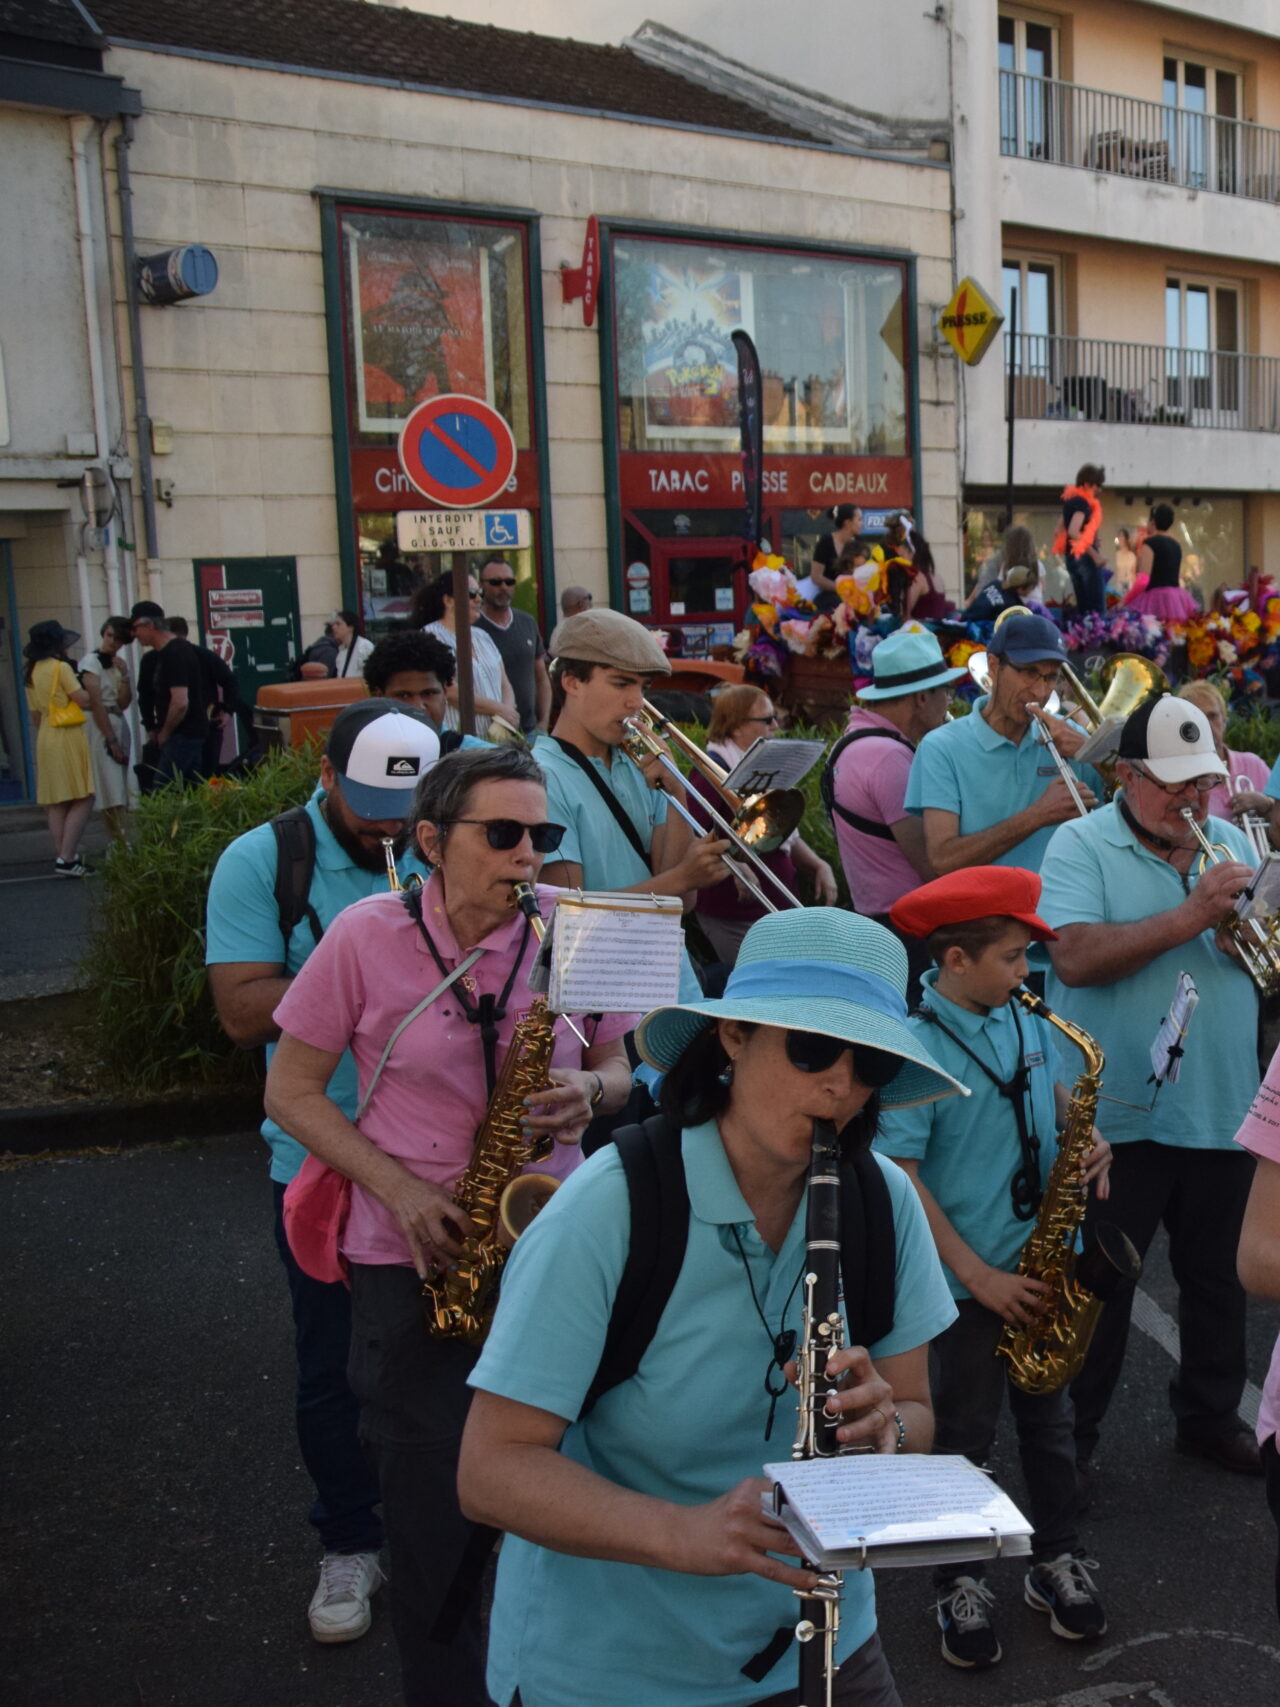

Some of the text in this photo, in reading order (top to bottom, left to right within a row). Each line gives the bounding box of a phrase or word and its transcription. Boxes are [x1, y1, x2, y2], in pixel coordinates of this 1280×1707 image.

[584, 237, 594, 304] TABAC
[942, 312, 987, 328] PRESSE
[649, 469, 888, 493] TABAC PSSE CADEAUX
[414, 514, 474, 524] INTERDIT
[429, 526, 462, 536] SAUF
